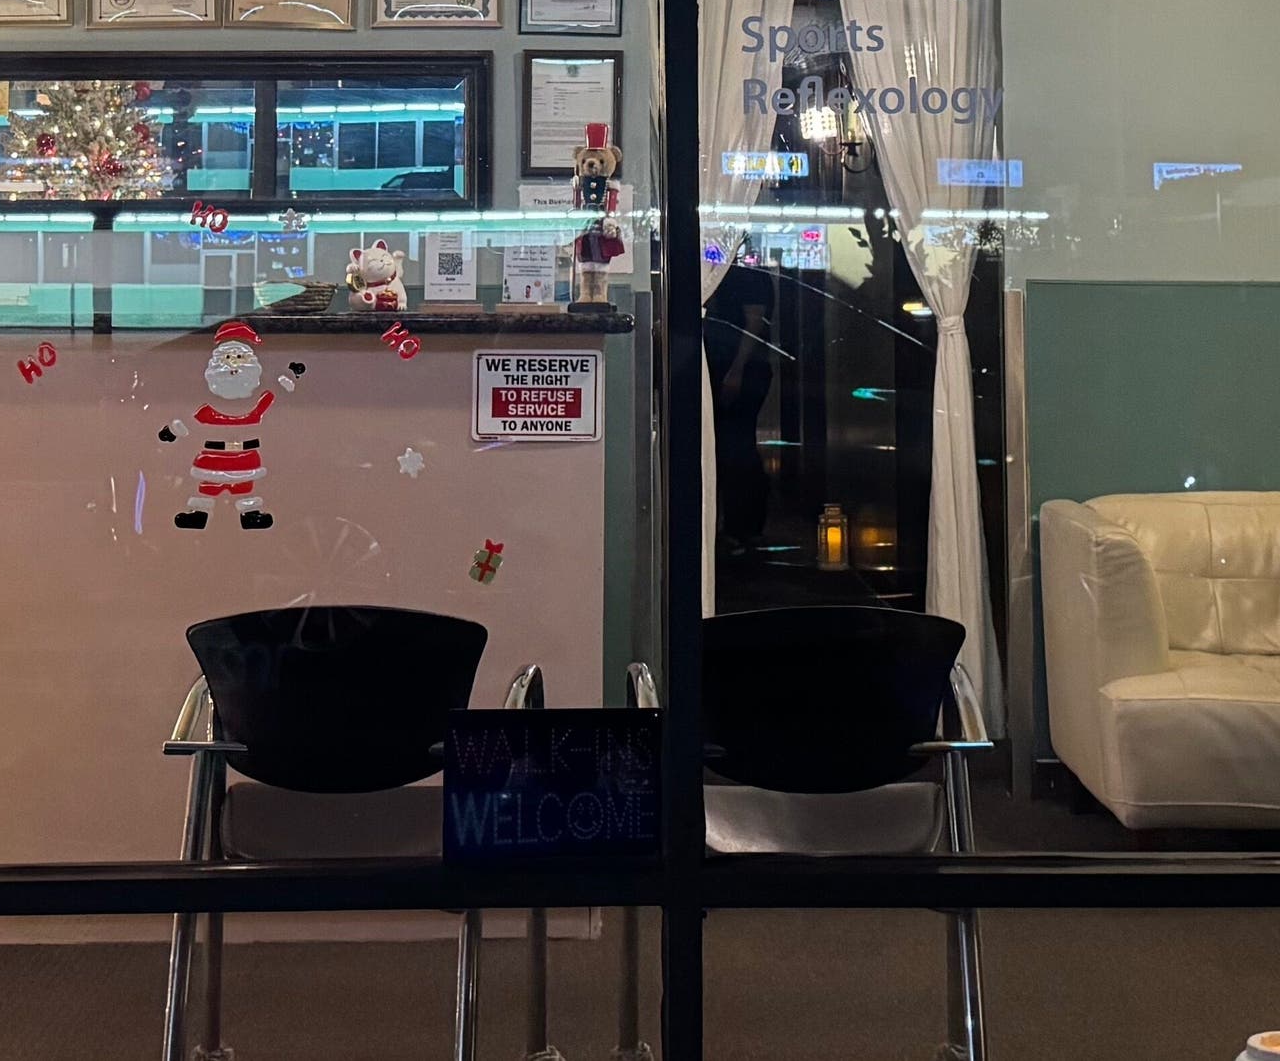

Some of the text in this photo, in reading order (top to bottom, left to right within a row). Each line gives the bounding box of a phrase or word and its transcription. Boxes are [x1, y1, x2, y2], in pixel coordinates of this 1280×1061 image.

[740, 16, 885, 62] Sports
[742, 76, 1004, 124] Reflexology
[190, 201, 229, 234] HO
[380, 321, 421, 361] HO
[17, 341, 57, 384] HO
[485, 359, 590, 373] WE RESERVE
[504, 374, 570, 386] THE RIGHT
[500, 390, 574, 402] TO REFUSE
[508, 404, 566, 416] SERVICE
[501, 420, 572, 432] TO ANYONE
[451, 727, 653, 775] WALK-INS
[451, 790, 656, 847] WELCOME
